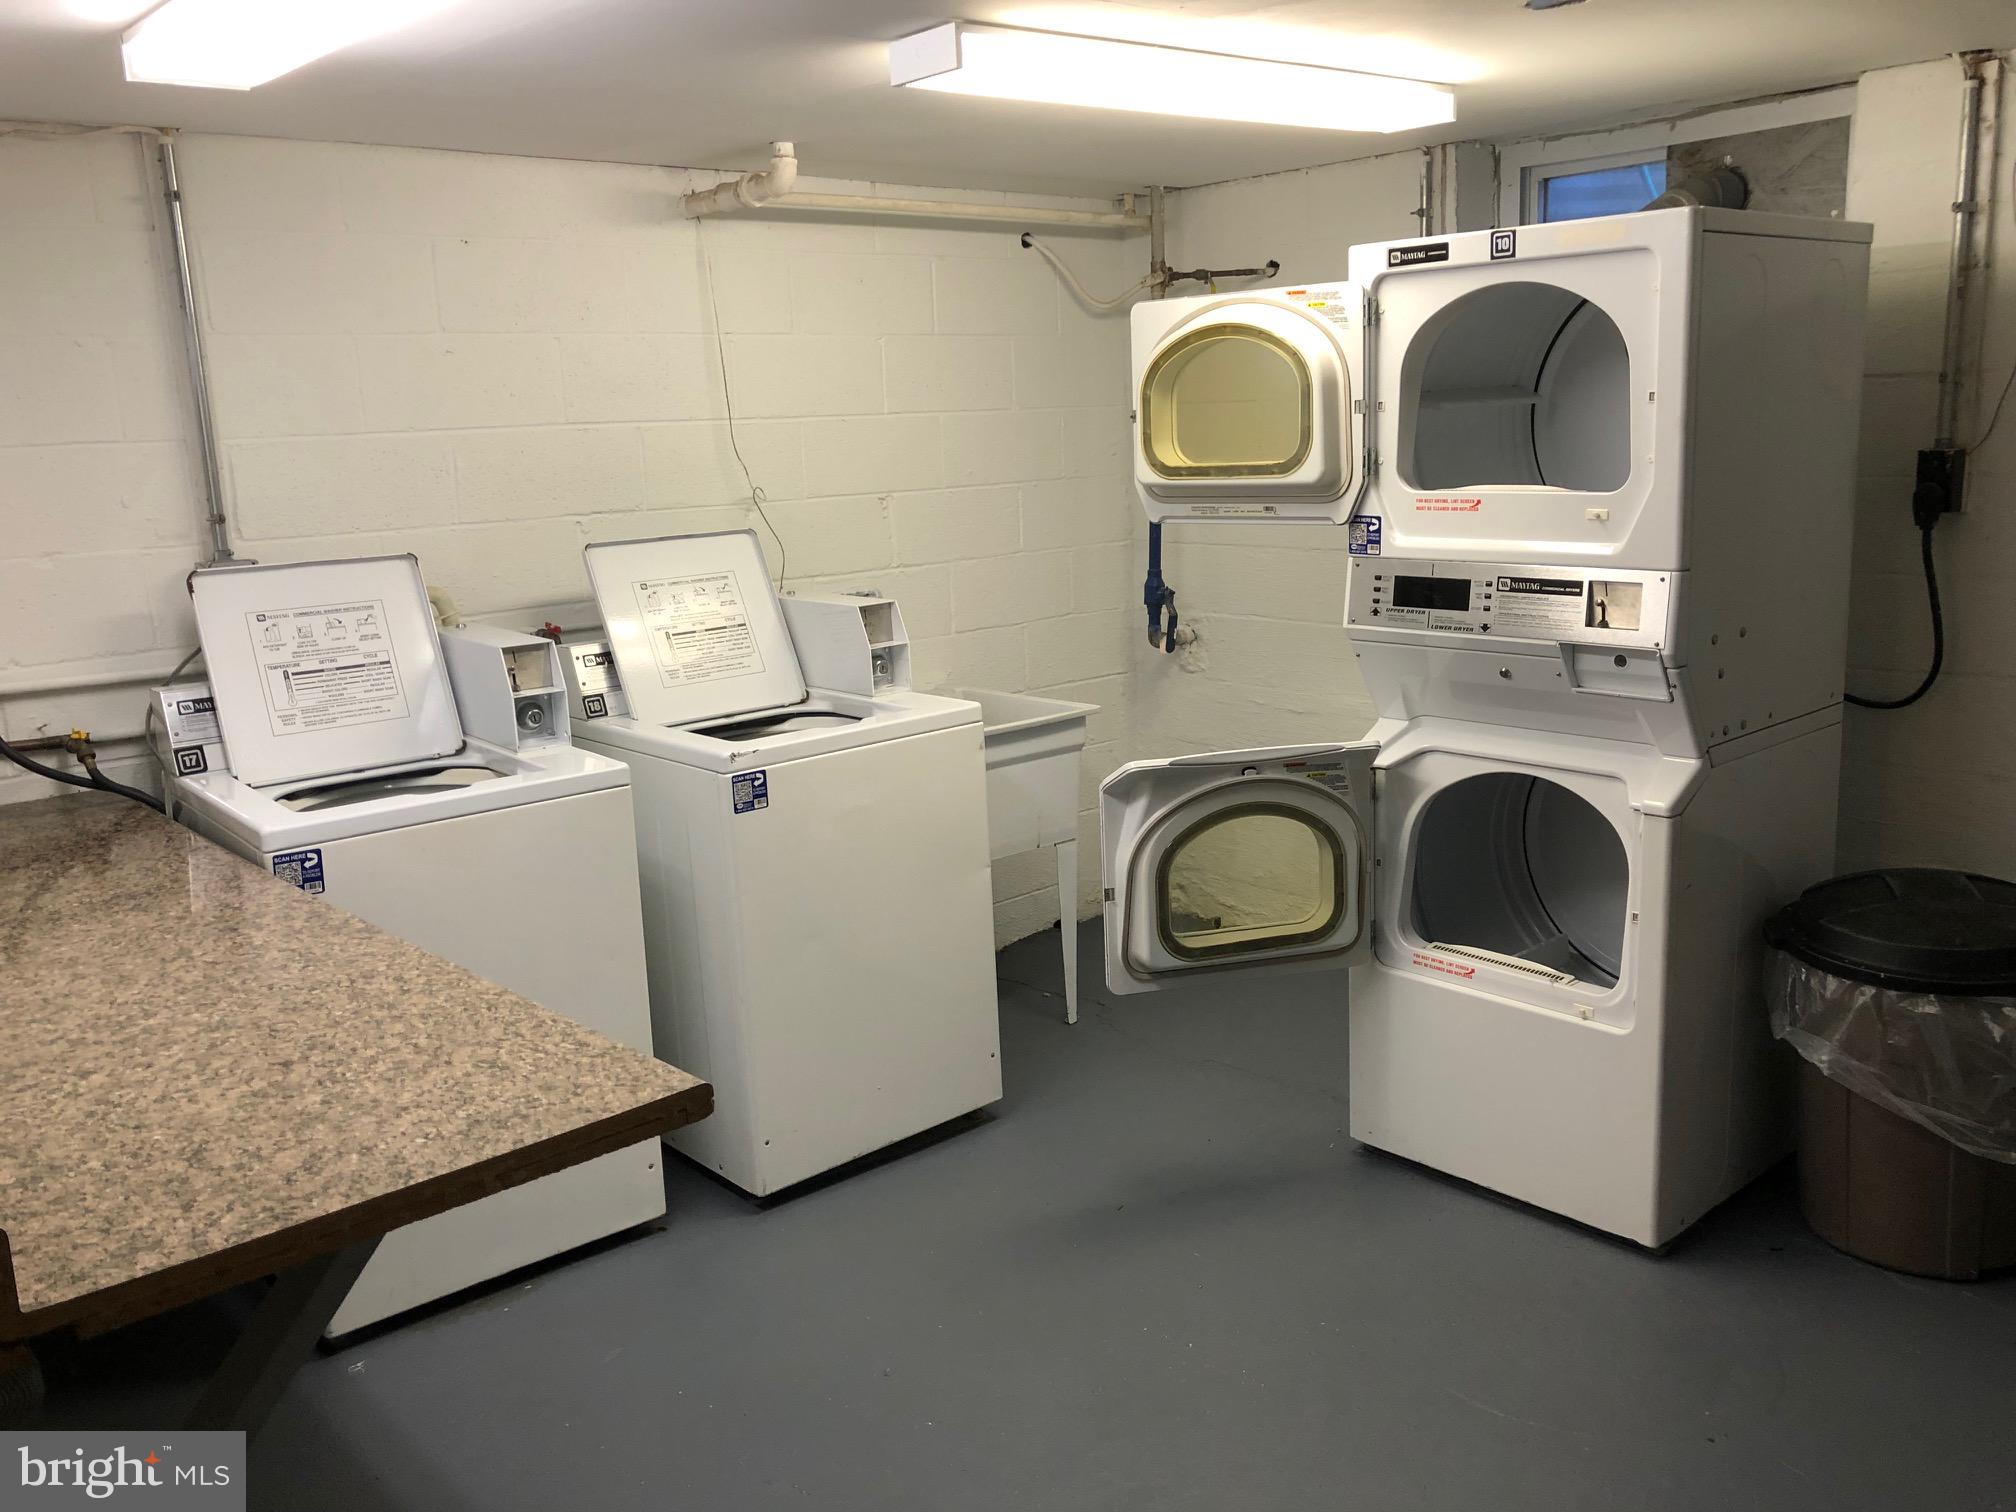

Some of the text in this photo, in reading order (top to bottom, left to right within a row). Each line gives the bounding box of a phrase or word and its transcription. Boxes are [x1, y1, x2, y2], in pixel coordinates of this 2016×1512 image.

[1496, 237, 1510, 251] 10
[1401, 251, 1425, 260] MAYTAG
[1511, 581, 1540, 590] MAYTAG
[267, 663, 300, 671] TEMPERATURE
[194, 701, 213, 710] MAY
[588, 701, 602, 712] 18
[182, 754, 198, 767] 17
[274, 853, 306, 863] SCAN HERE
